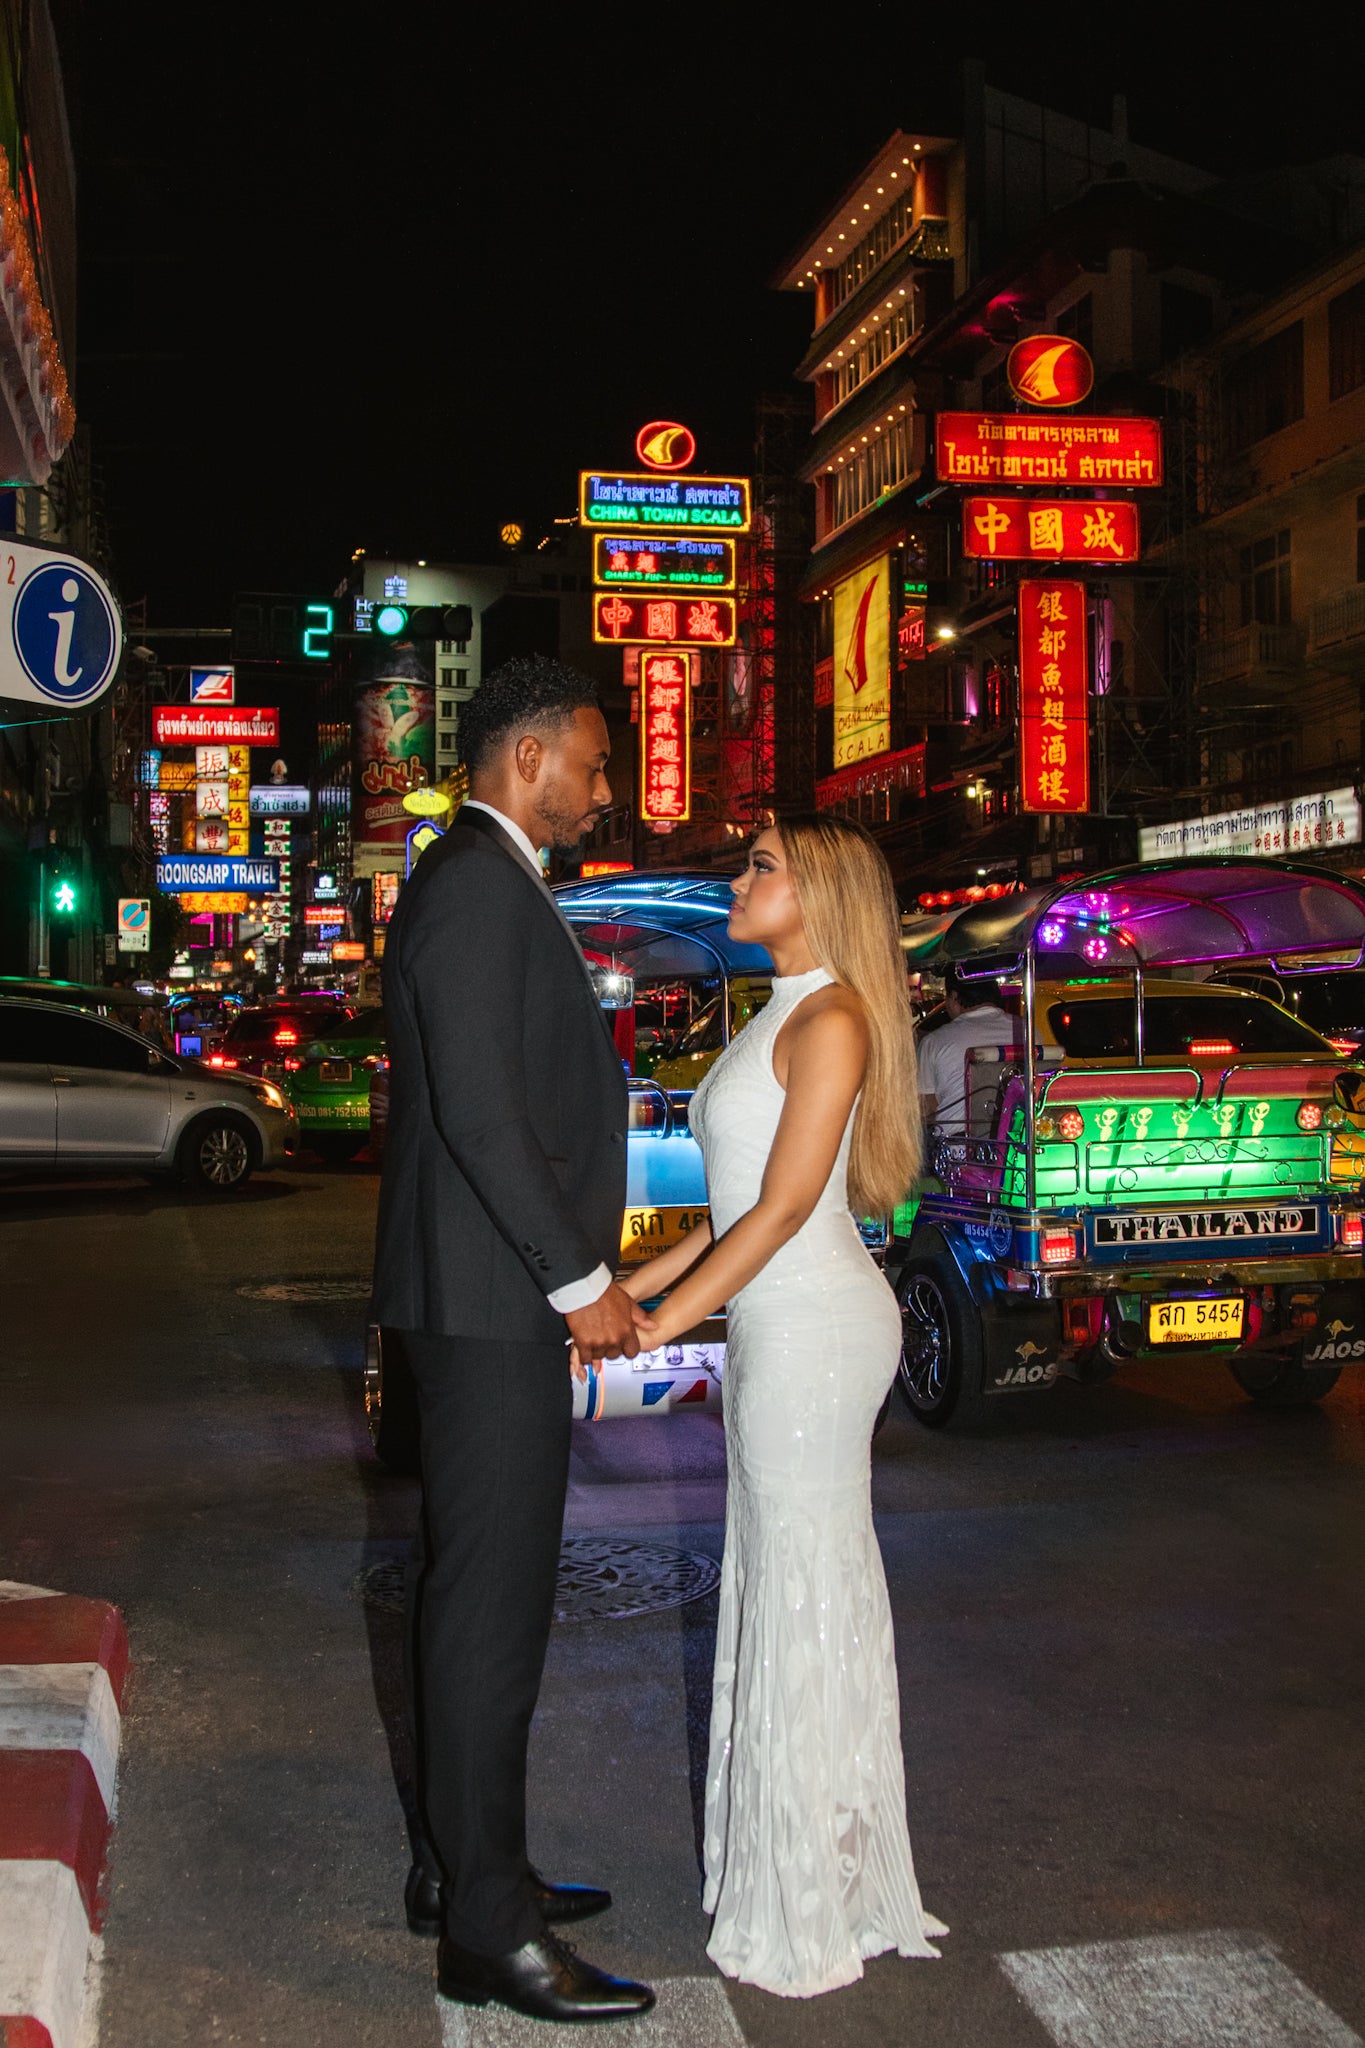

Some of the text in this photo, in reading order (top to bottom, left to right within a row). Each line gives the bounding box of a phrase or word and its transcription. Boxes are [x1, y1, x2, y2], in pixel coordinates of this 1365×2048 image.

[944, 441, 1154, 479] ไชน่าทาวน์ สกาล่า
[589, 505, 743, 525] CHINA TOWN SCALA
[973, 503, 1124, 555] 中國城
[304, 605, 332, 656] 2
[602, 598, 724, 641] 中國城
[838, 698, 885, 733] CHINA TOWN
[837, 732, 885, 764] SCALA
[156, 864, 276, 884] ROONGSARP TRAVEL
[1109, 1209, 1304, 1241] THAILAND
[1196, 1302, 1241, 1324] 5454
[1305, 1340, 1365, 1361] JAOS
[995, 1363, 1057, 1386] JAOS
